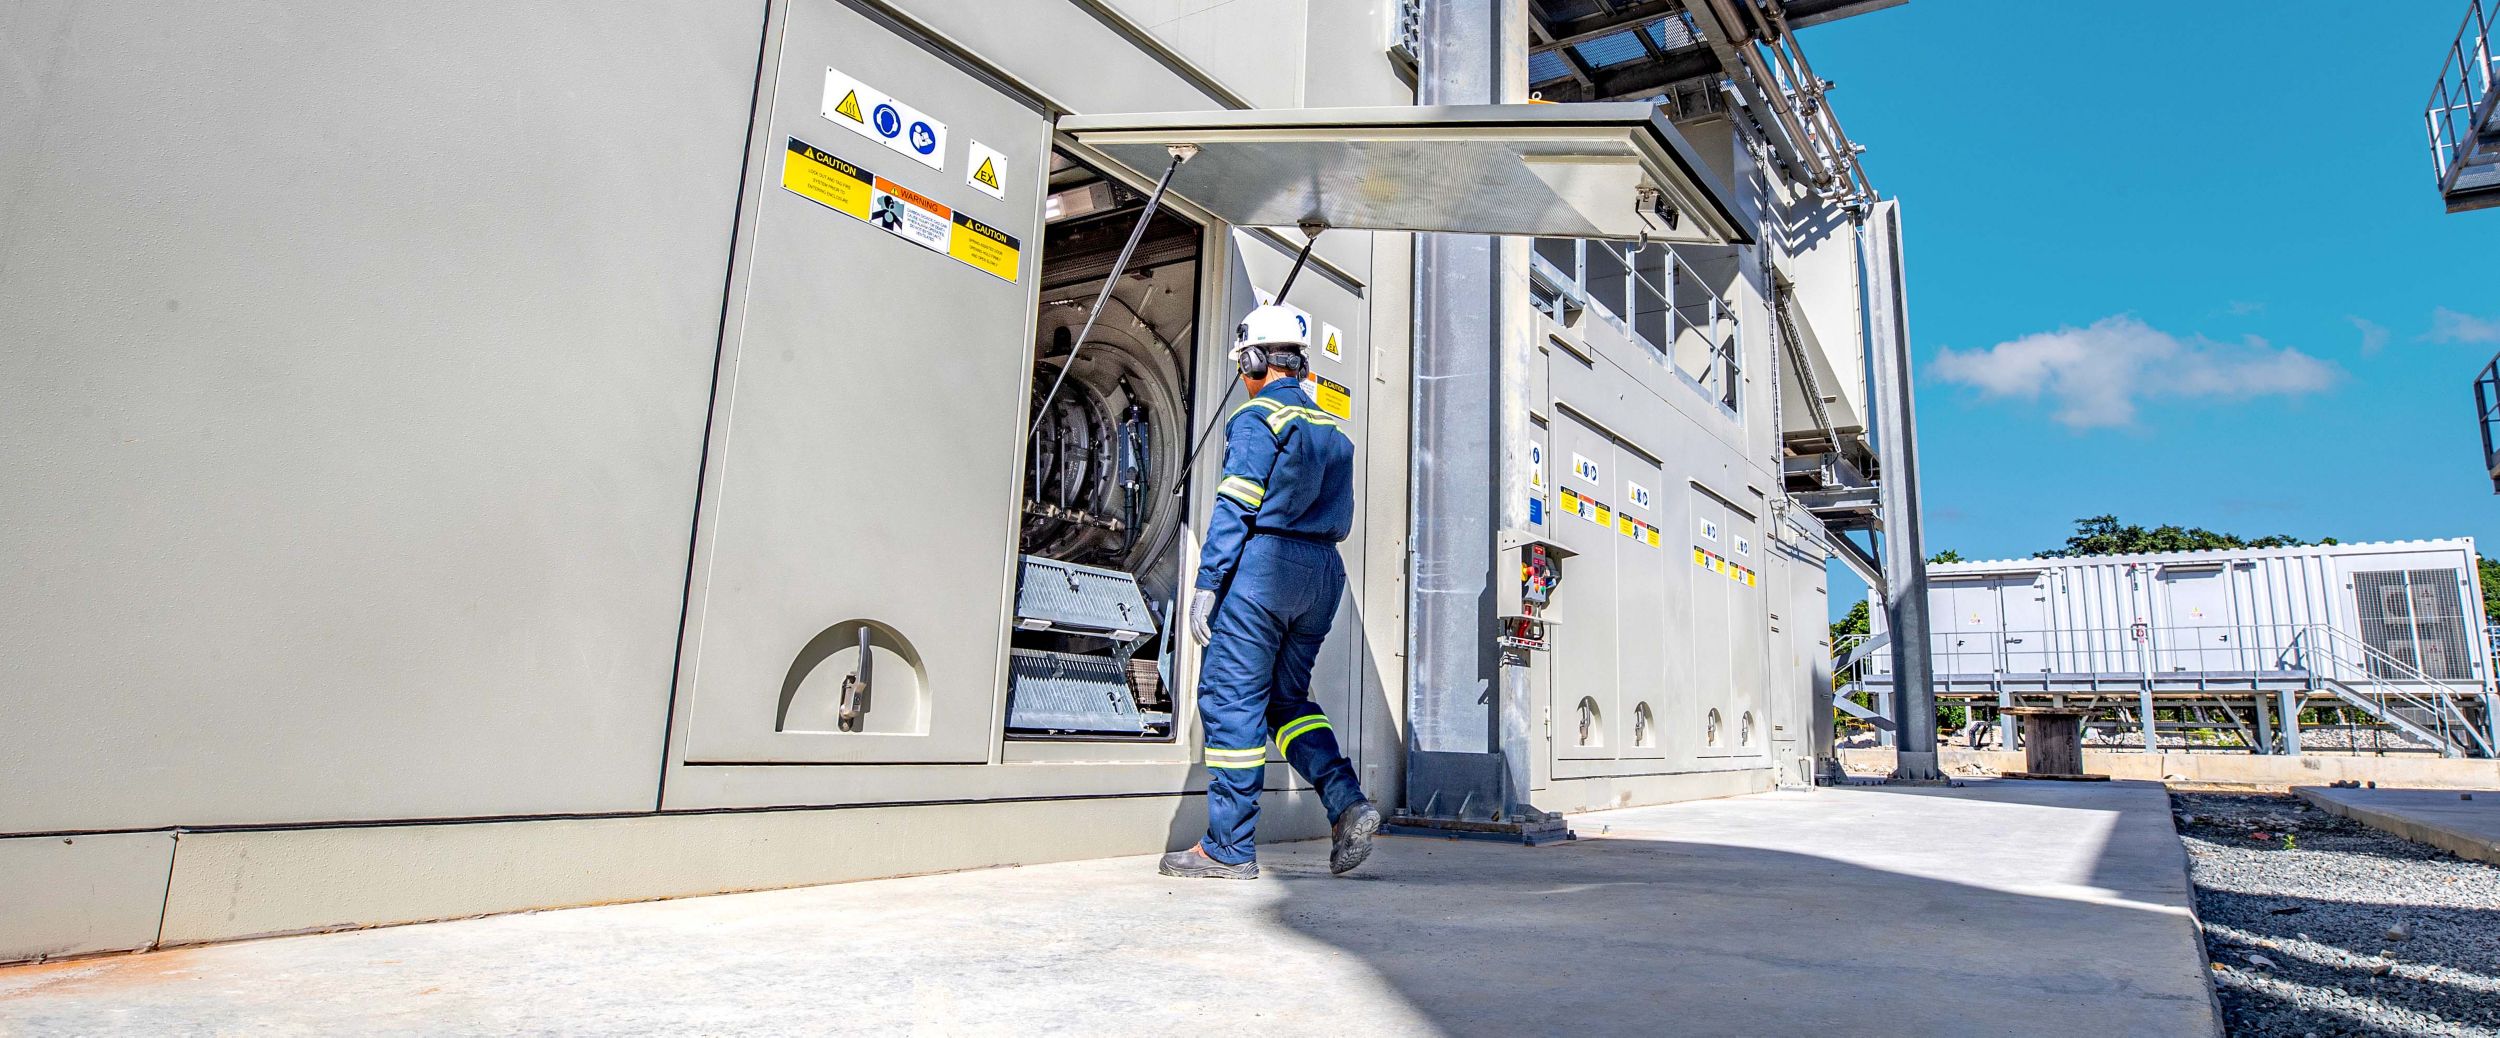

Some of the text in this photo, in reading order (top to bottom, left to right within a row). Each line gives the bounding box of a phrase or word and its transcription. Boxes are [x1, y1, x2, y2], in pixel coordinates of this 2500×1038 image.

[816, 152, 857, 176] CAUTION
[981, 170, 993, 184] EX
[901, 189, 938, 212] WARNING
[975, 223, 1007, 243] CAUTION
[1328, 381, 1344, 393] CAUTION
